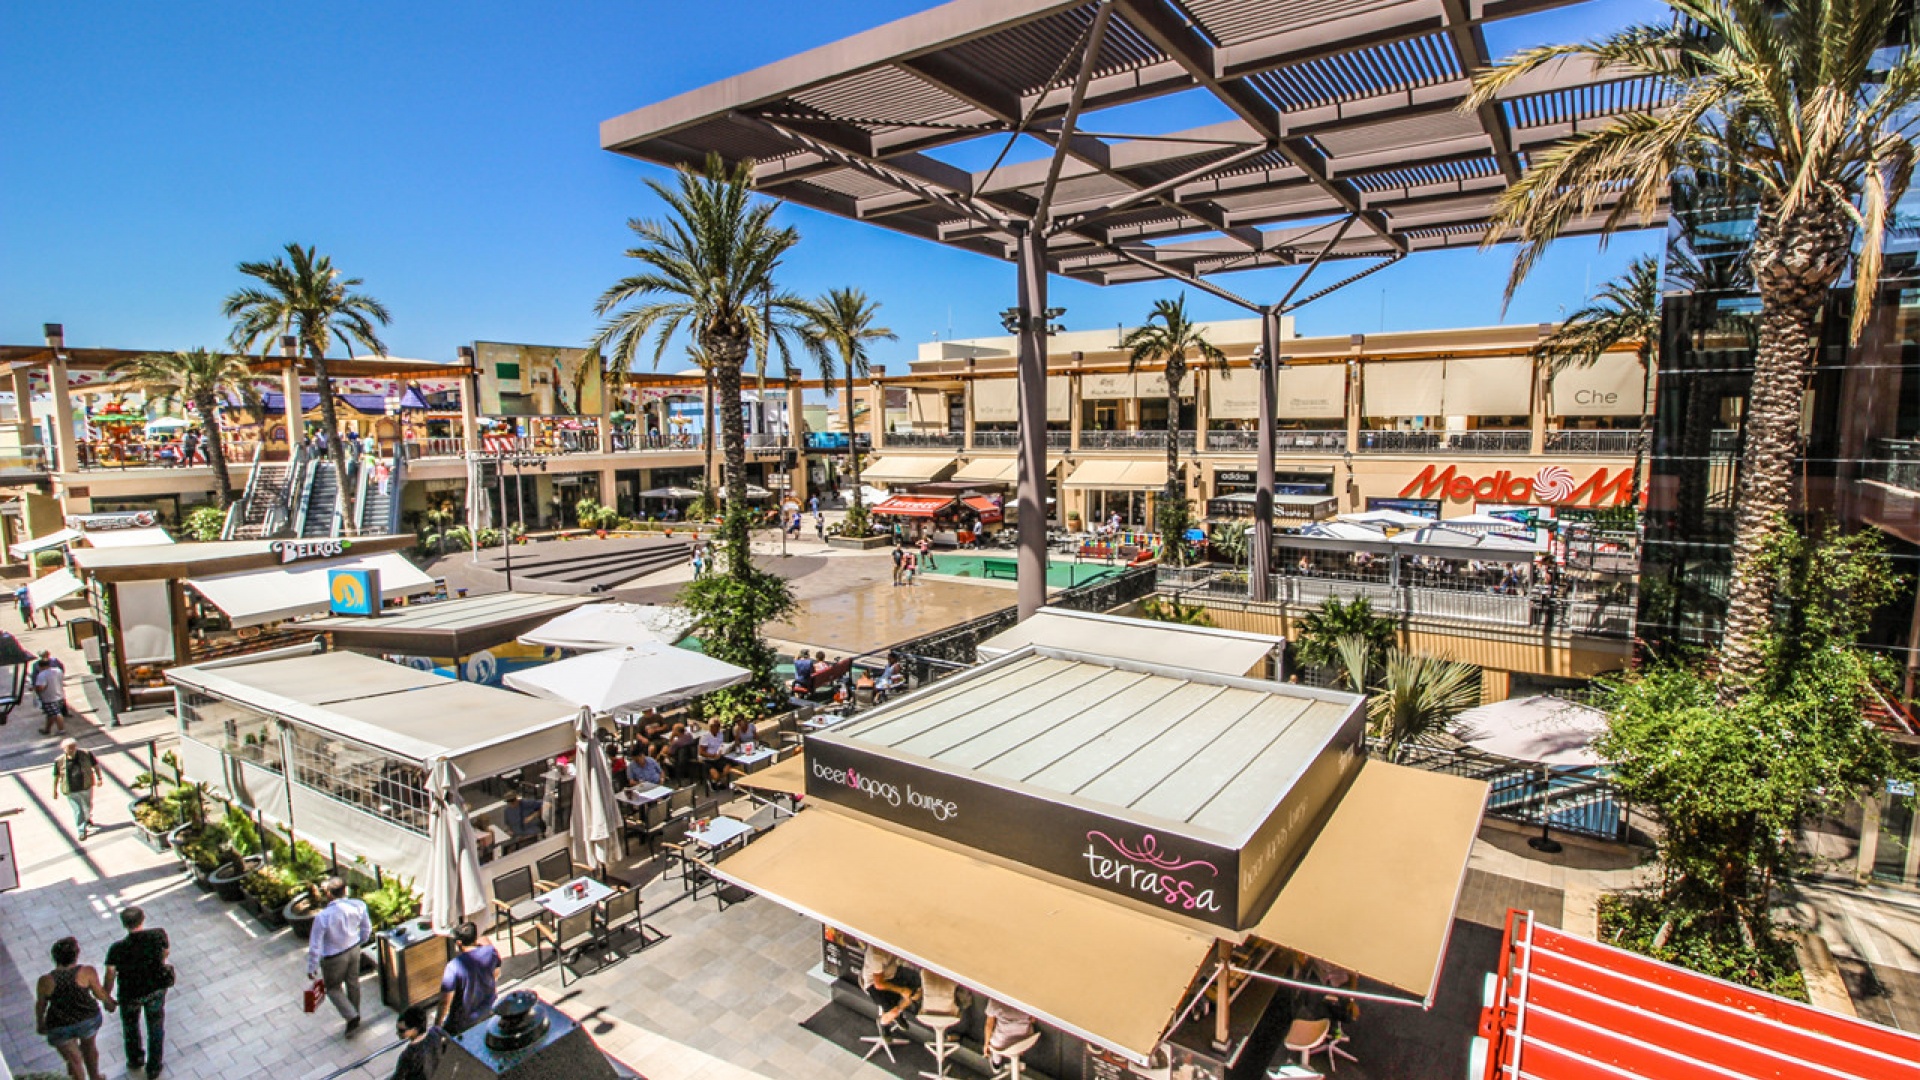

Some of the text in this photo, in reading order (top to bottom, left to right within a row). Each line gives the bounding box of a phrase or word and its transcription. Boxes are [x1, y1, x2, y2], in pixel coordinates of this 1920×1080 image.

[1575, 389, 1618, 404] Che
[1221, 472, 1249, 481] adidas
[1399, 465, 1533, 500] Media
[907, 784, 958, 820] lounge
[1083, 844, 1221, 912] terrassa
